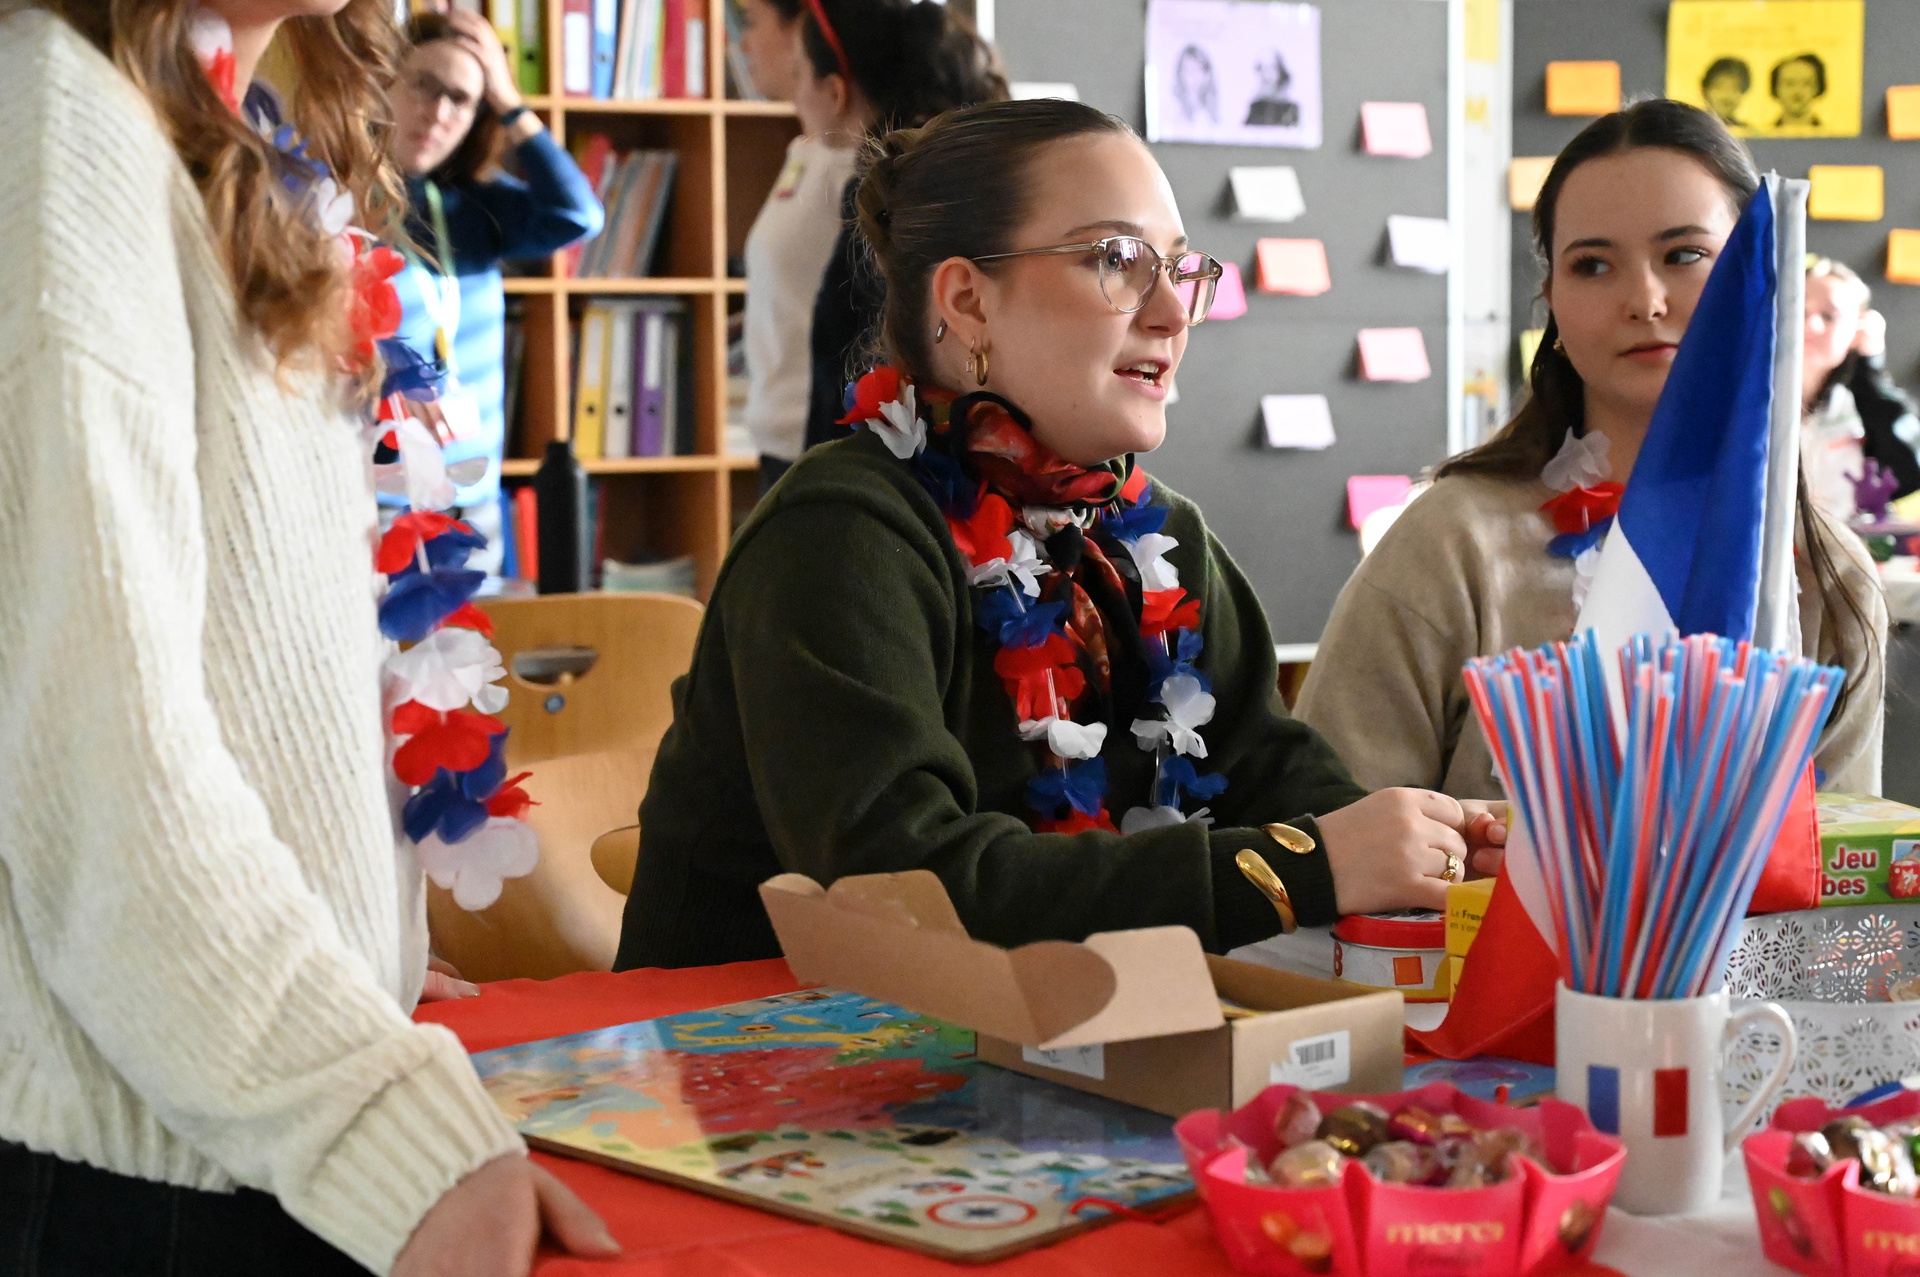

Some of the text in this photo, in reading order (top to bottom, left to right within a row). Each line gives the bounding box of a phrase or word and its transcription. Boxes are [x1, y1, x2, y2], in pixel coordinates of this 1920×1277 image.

[1830, 846, 1877, 870] Jeu
[1821, 873, 1866, 896] bes
[1462, 909, 1484, 921] Fran
